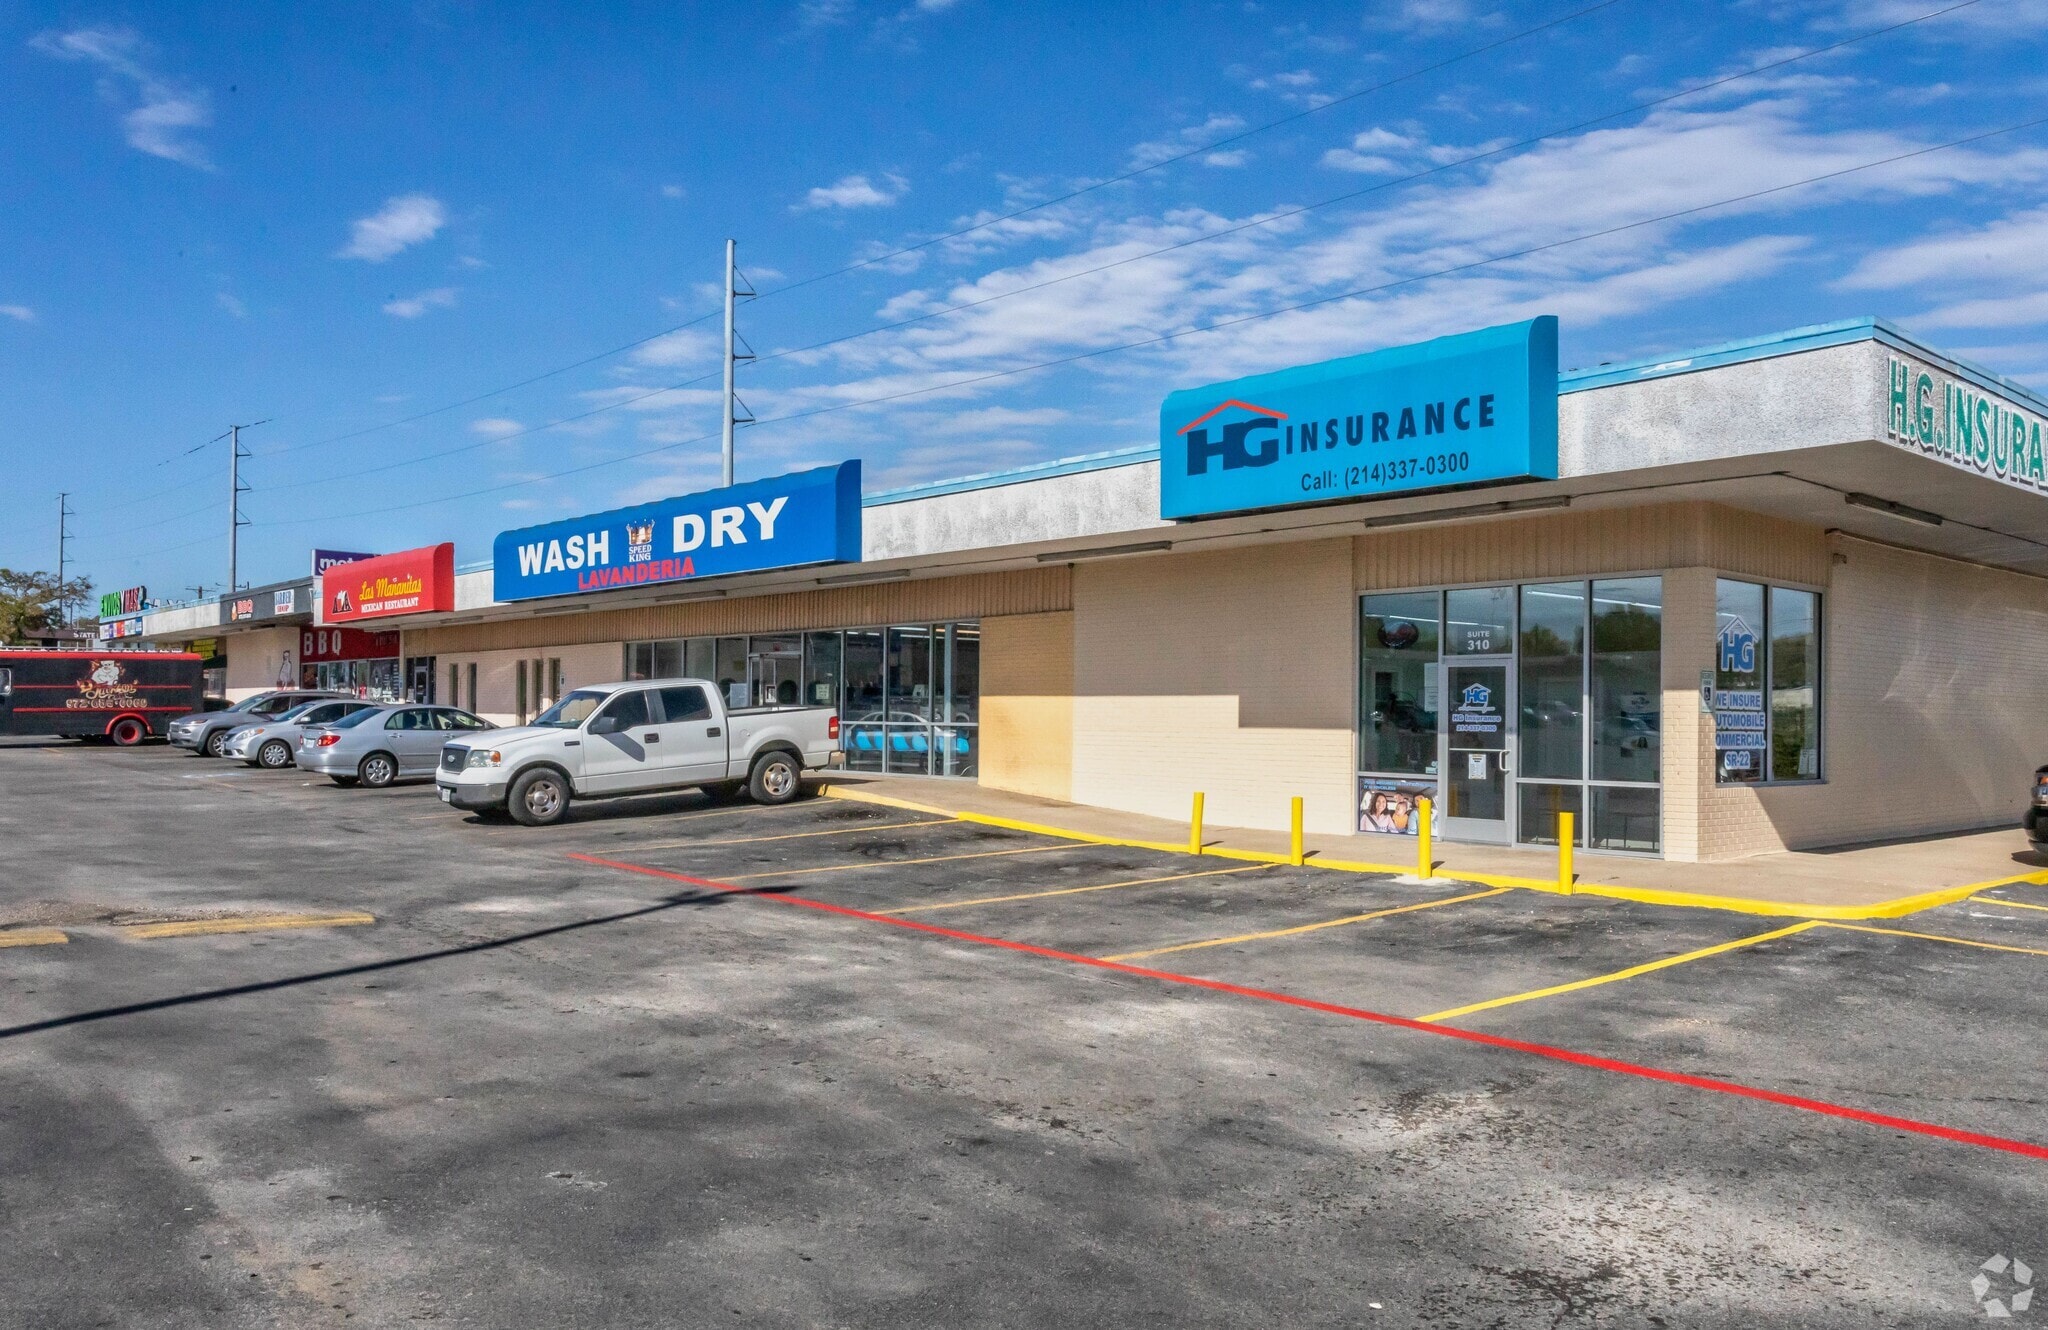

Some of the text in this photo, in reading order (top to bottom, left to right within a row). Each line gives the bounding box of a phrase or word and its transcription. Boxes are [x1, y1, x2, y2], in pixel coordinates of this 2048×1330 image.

[1187, 394, 1495, 476] HG INSURANCE
[1301, 451, 1470, 491] Call: (214)337-0300
[518, 496, 789, 577] WASH DRY
[628, 544, 652, 554] SPEED
[629, 553, 651, 562] KING
[578, 557, 695, 590] LAVANDERIA
[359, 581, 374, 600] Las
[361, 597, 419, 613] MEXICAN RESTAURANT
[1467, 630, 1490, 638] SUITE
[303, 629, 342, 656] BBQ
[1467, 639, 1490, 650] 310
[1721, 632, 1754, 671] HG
[1465, 688, 1489, 704] HG
[1729, 694, 1761, 708] INSURE
[1452, 714, 1501, 722] HG Insurance
[1716, 713, 1765, 728] UTOMOBILE
[1716, 732, 1765, 747] OMMERCIAL
[1726, 753, 1750, 767] SR-22
